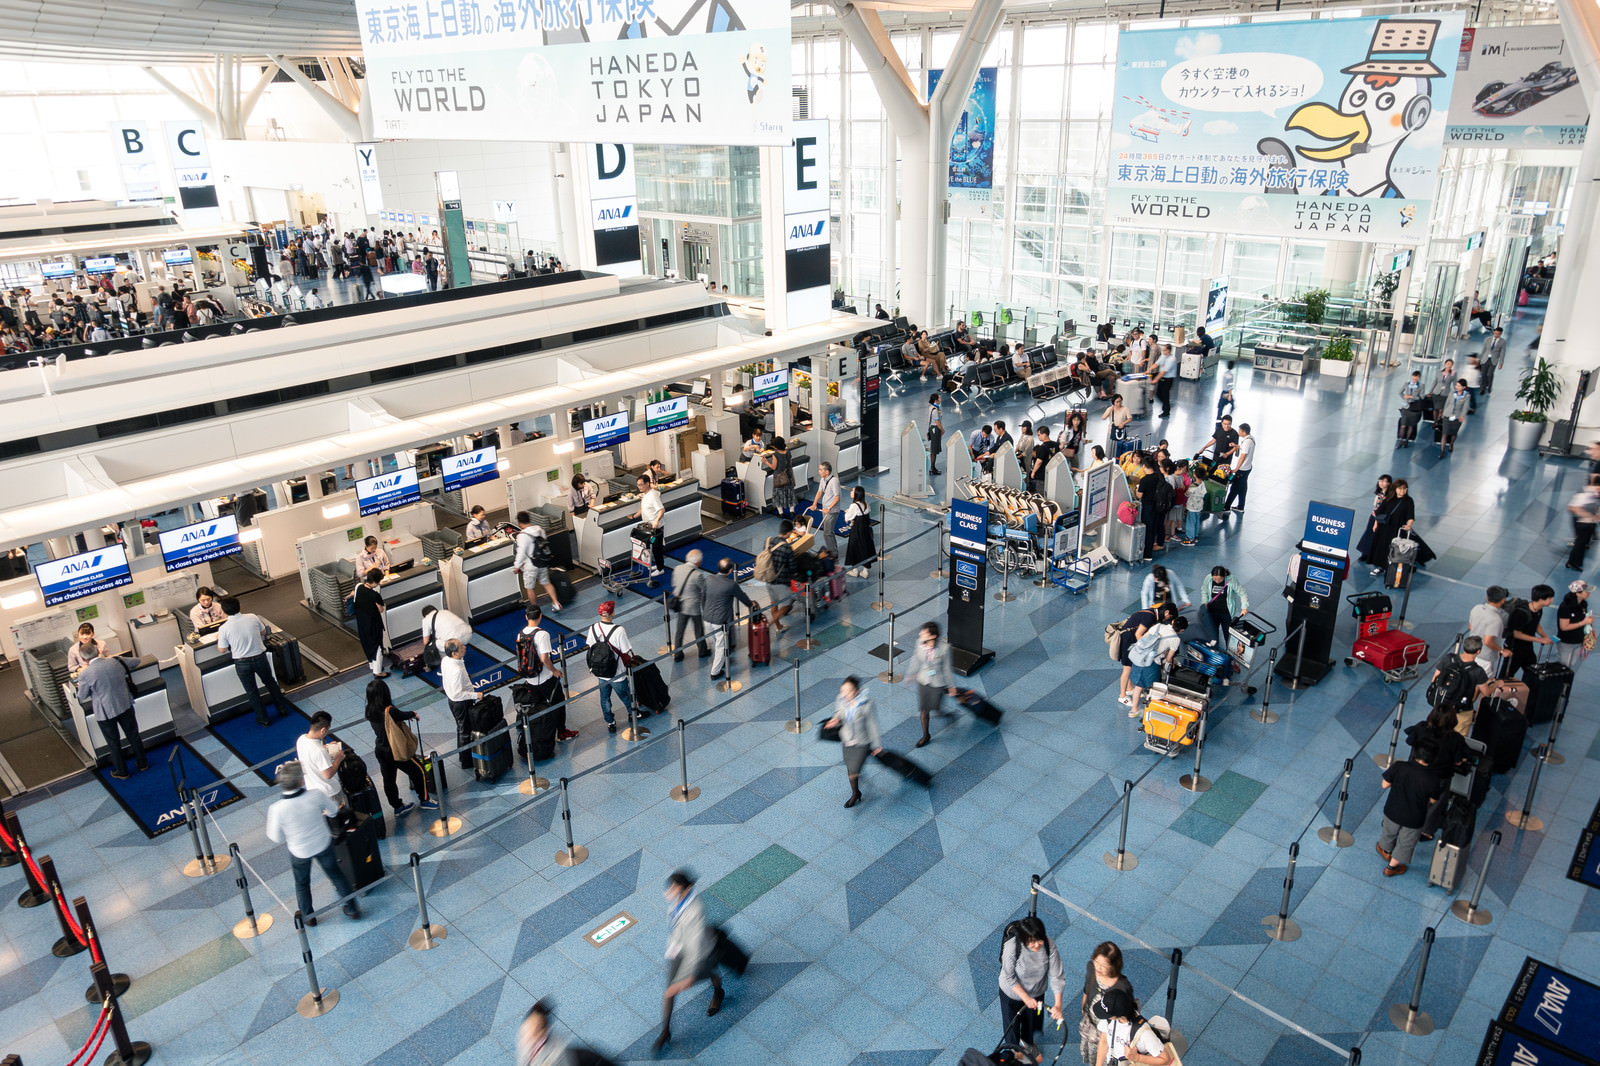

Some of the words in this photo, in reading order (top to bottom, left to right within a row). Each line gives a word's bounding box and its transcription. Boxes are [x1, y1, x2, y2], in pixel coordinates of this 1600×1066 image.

[590, 51, 698, 75] HANEDA
[391, 71, 413, 84] FLY
[417, 70, 434, 83] TO
[438, 68, 466, 82] THE
[1181, 67, 1250, 80] 今すぐ空港の
[592, 77, 701, 99] TOKYO
[394, 86, 486, 112] WORLD
[596, 103, 702, 123] JAPAN
[122, 129, 144, 154] B
[178, 129, 201, 156] C
[1450, 133, 1505, 141] WORLD
[359, 149, 372, 166] Y
[596, 143, 626, 180] D
[796, 137, 817, 191] E
[1118, 164, 1350, 189] 東京海上日動の海外旅行保険
[1131, 194, 1151, 202] FLY
[1156, 195, 1169, 203] TO
[1174, 196, 1197, 204] THE
[1296, 201, 1371, 212] HANEDA
[598, 207, 621, 221] ANA
[1131, 203, 1211, 219] WORLD
[1296, 211, 1371, 223] TOKYO
[790, 223, 813, 240] ANA
[1294, 221, 1369, 233] JAPAN
[230, 246, 239, 257] C
[839, 357, 847, 376] E
[657, 404, 671, 415] ANA
[595, 420, 610, 431] ANA
[456, 457, 475, 468] ANA
[373, 479, 393, 491] ANA
[955, 511, 982, 524] BUSINESS
[1312, 515, 1346, 529] BUSINESS
[959, 521, 978, 531] CLASS
[1316, 525, 1339, 536] CLASS
[181, 529, 206, 543] ANA
[175, 561, 192, 569] closes
[203, 551, 226, 561] check-in
[61, 560, 90, 576] ANA
[1540, 976, 1571, 1014] ANA
